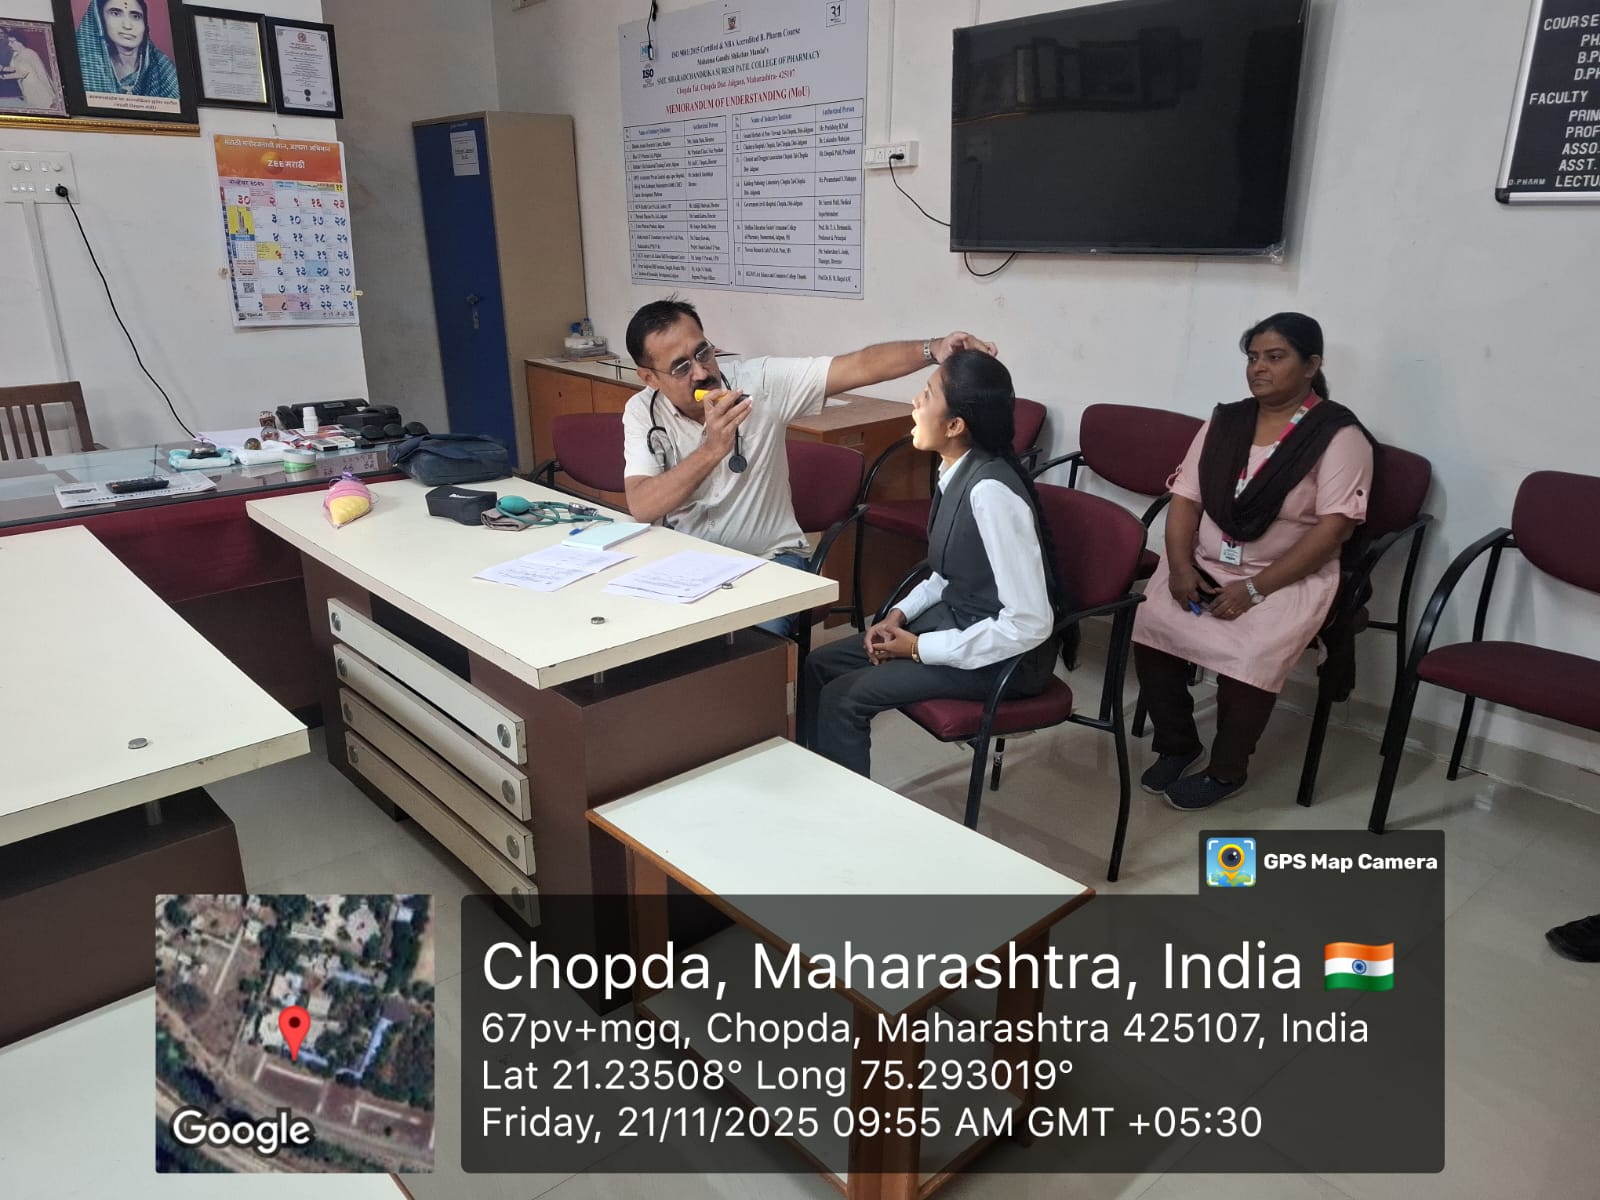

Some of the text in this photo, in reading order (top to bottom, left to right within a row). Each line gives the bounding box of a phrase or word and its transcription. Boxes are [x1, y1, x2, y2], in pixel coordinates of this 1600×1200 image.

[1543, 14, 1600, 31] COURSE
[766, 30, 782, 41] Pharm
[783, 27, 801, 37] Course
[751, 57, 778, 71] COLLEGE
[778, 56, 787, 65] OF
[787, 50, 821, 64] PHARMACY
[642, 69, 654, 79] ISO
[665, 86, 811, 115] MEMORANDUM OF UNDERSTANDING (MoU)
[1529, 90, 1589, 105] FACULTY
[267, 160, 285, 168] ZEE
[1558, 158, 1598, 172] ASST.
[1508, 177, 1546, 187] D.PHARM
